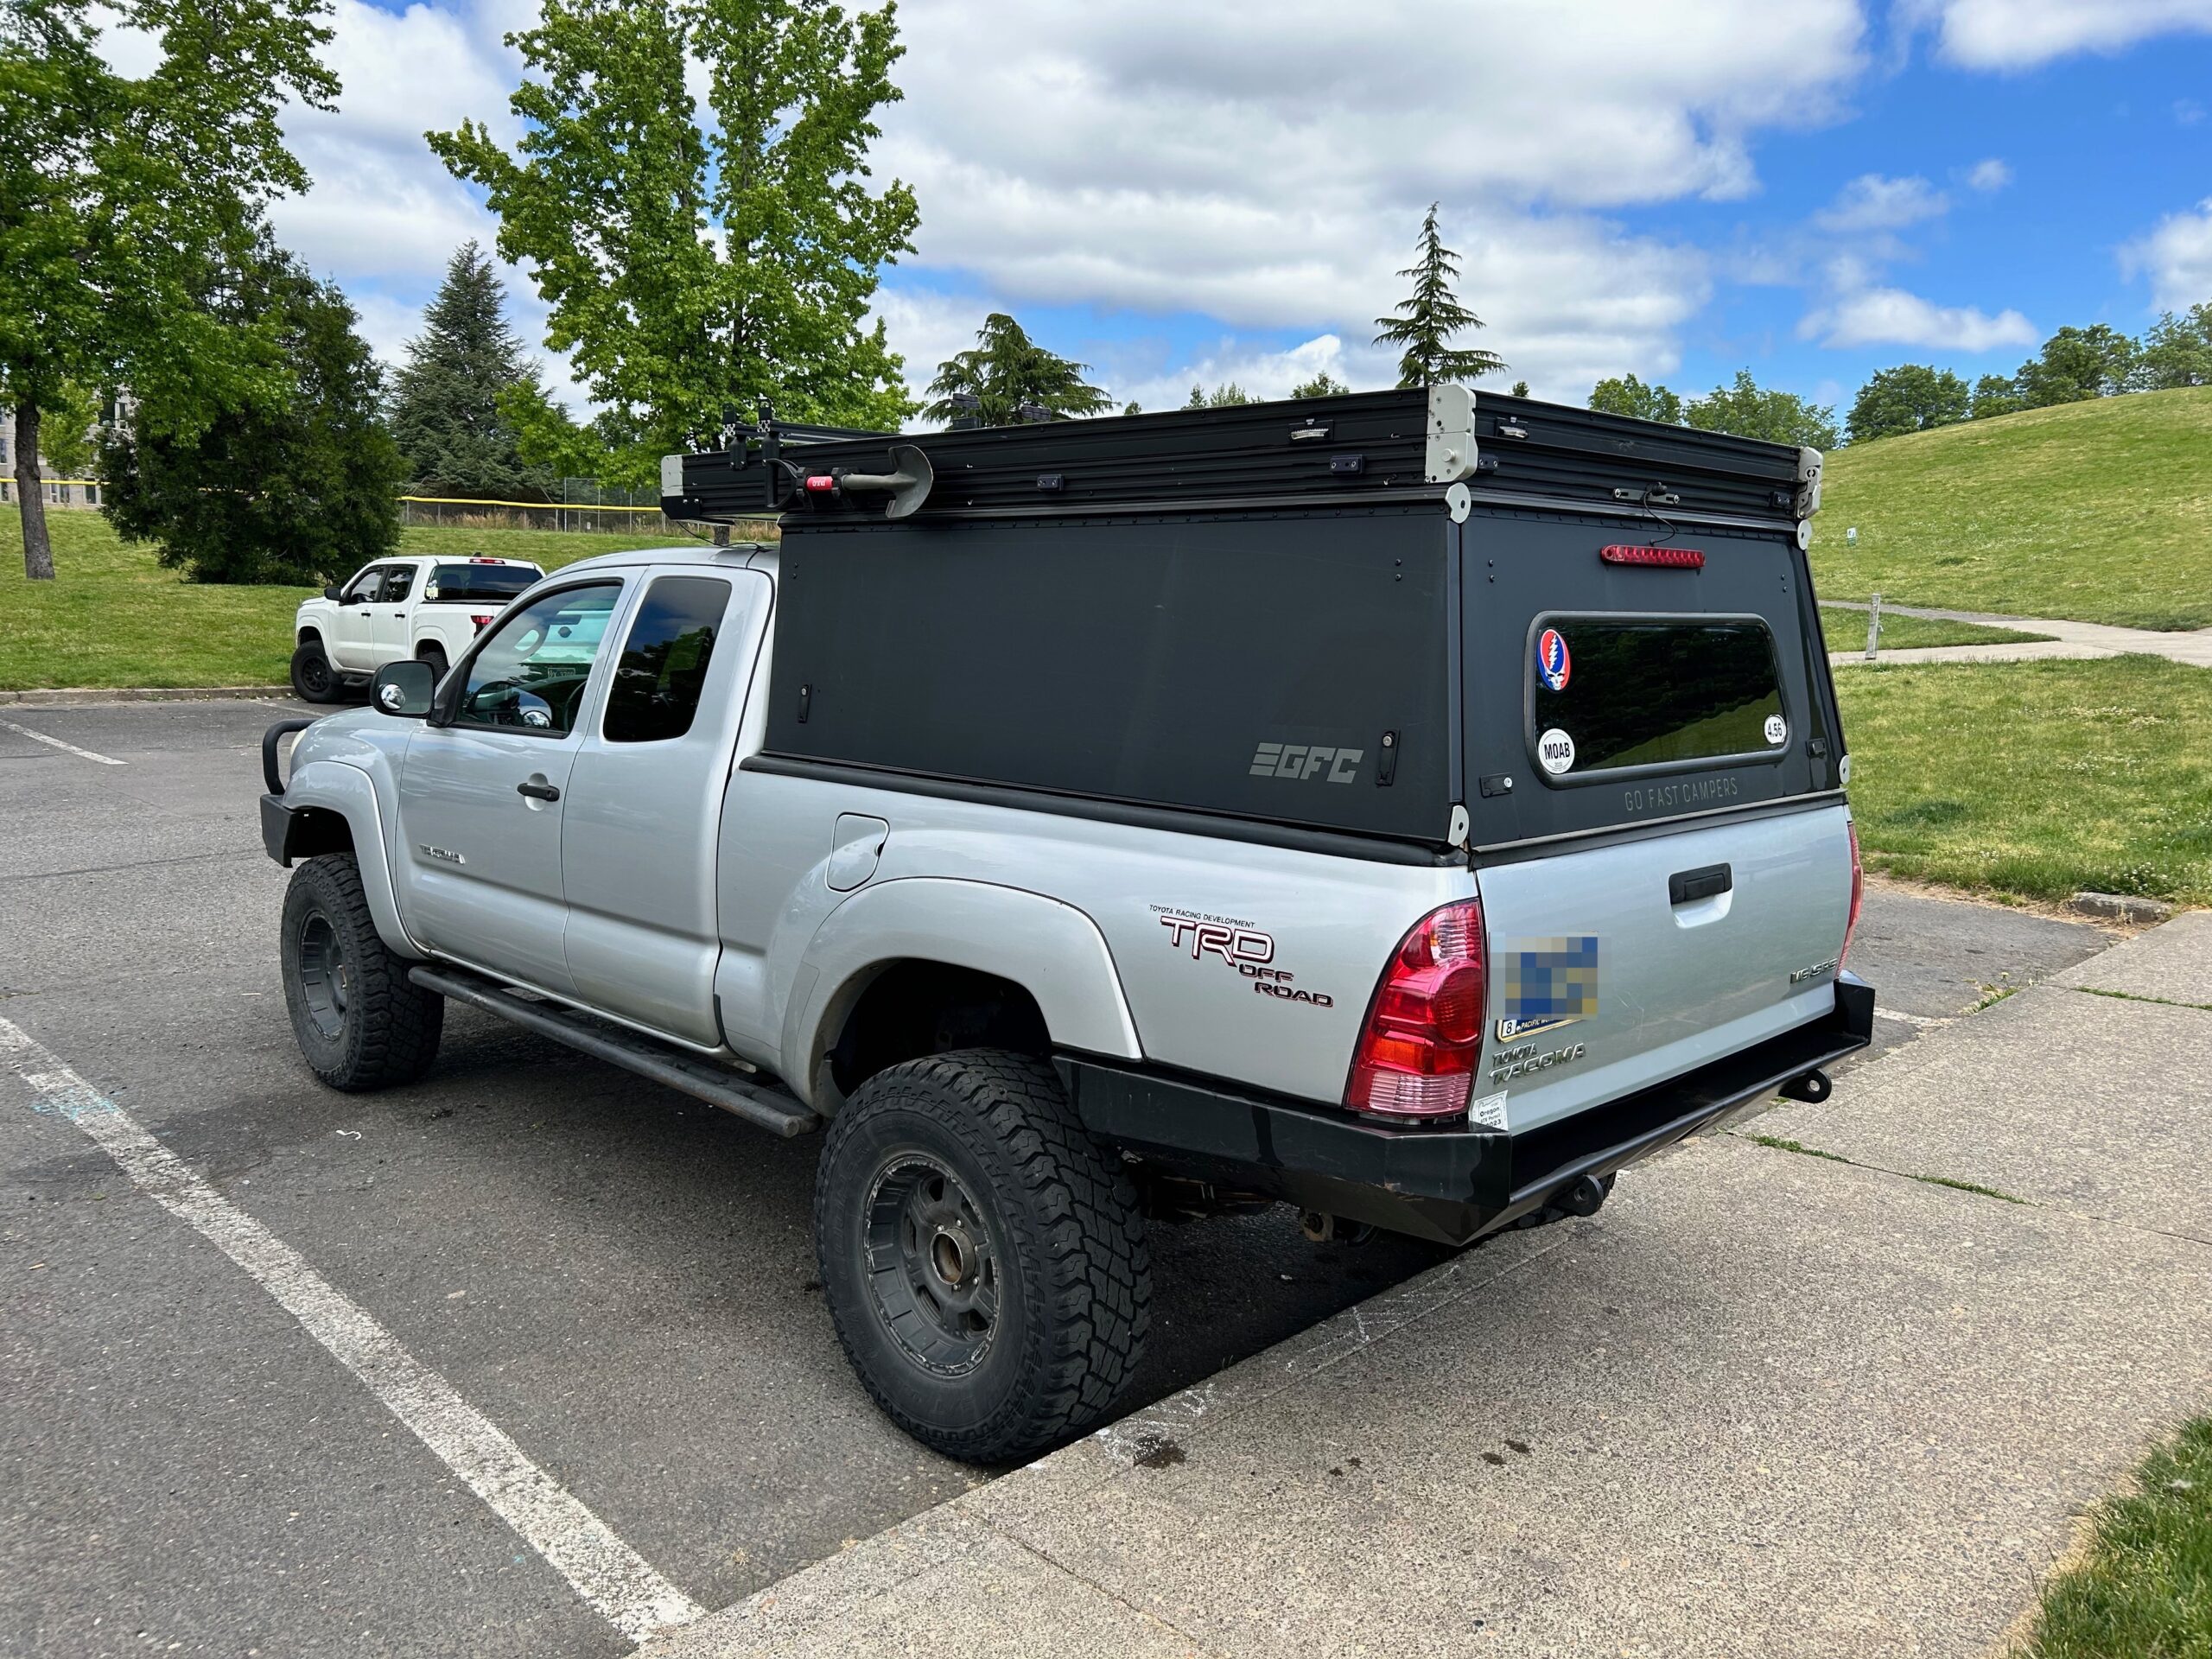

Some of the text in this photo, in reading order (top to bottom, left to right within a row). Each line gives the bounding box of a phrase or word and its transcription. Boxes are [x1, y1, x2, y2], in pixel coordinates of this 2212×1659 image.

[1768, 722, 1783, 737] 4.56
[1544, 742, 1571, 760] MOAB
[1624, 777, 1738, 811] GO FAST CAMPERS
[1149, 904, 1255, 929] TOYOTA RACING DEVELOPMENT
[1160, 915, 1274, 968] TRD
[1238, 963, 1294, 982] OFF
[1254, 982, 1334, 1007] ROAD
[1506, 1021, 1514, 1034] 8
[1521, 1020, 1541, 1030] PACIFIC
[1488, 1042, 1586, 1085] TACOMA
[1492, 1042, 1537, 1067] TOYOTA
[1479, 1107, 1500, 1117] Oregon
